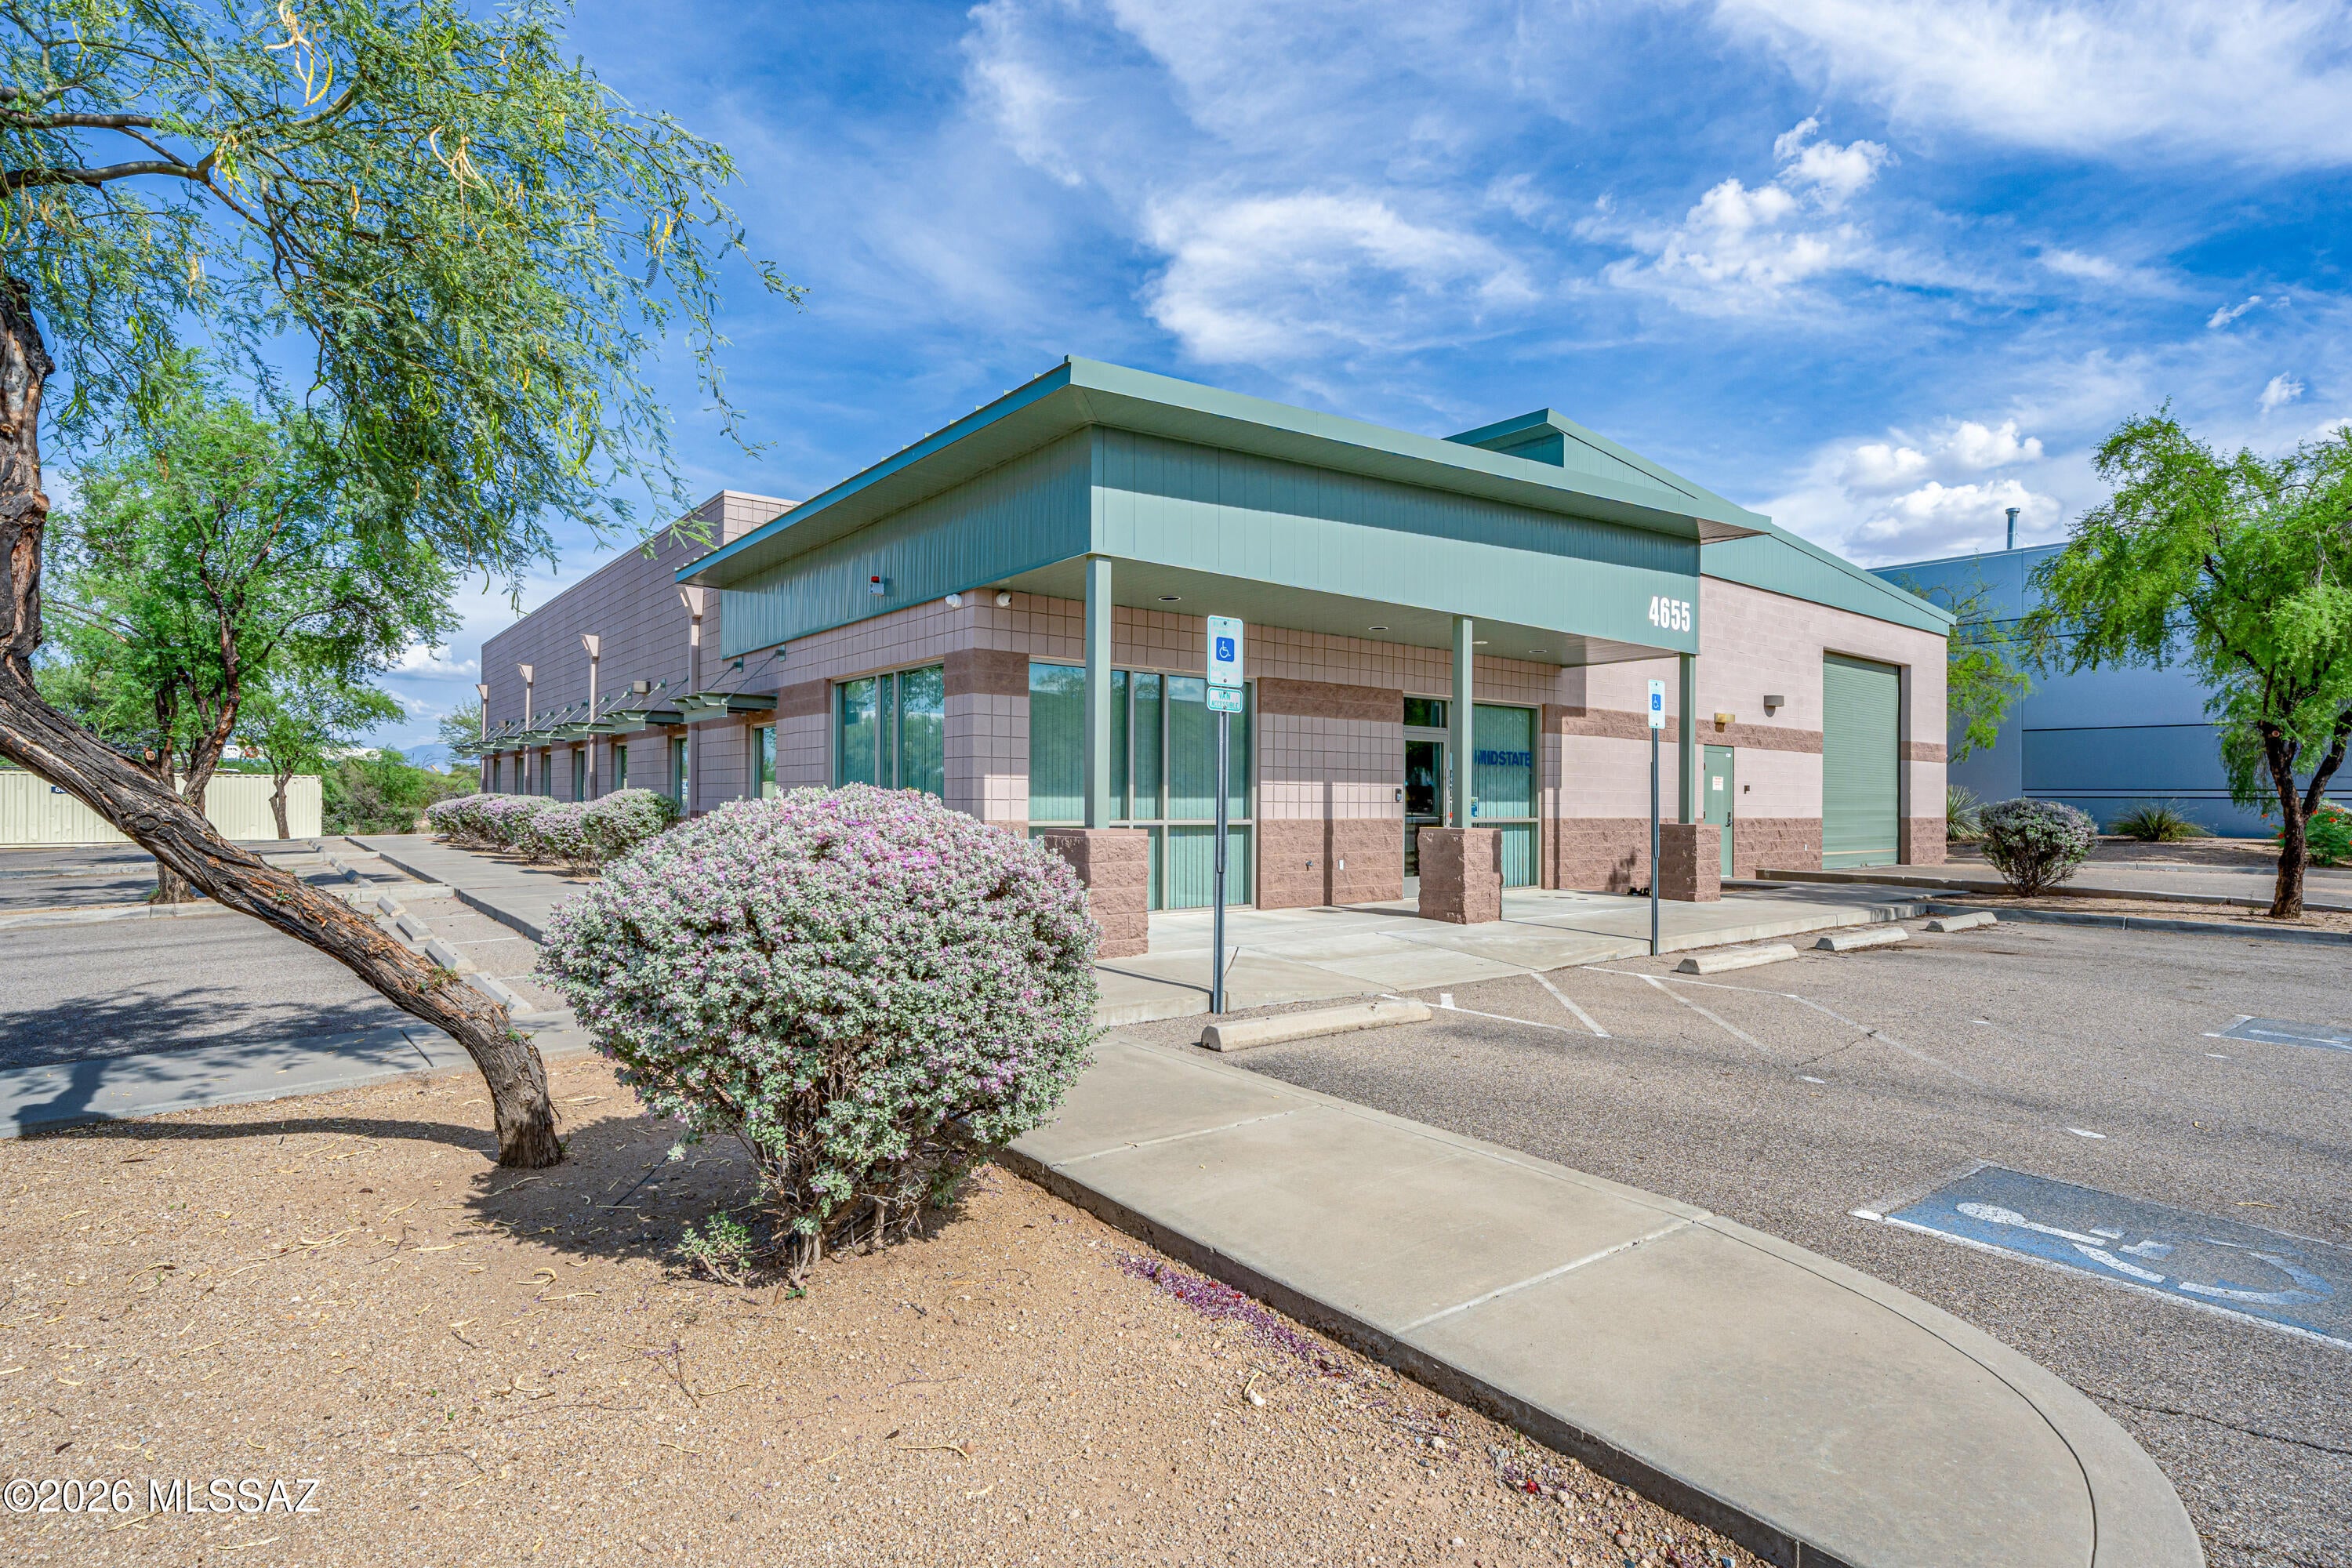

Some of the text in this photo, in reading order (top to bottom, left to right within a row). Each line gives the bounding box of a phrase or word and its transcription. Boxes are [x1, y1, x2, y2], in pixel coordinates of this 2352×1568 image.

[1649, 596, 1690, 632] 4655
[1218, 691, 1231, 700] VAN
[1211, 700, 1239, 709] ACCESSIBLE
[1477, 750, 1532, 767] MIDSTATE
